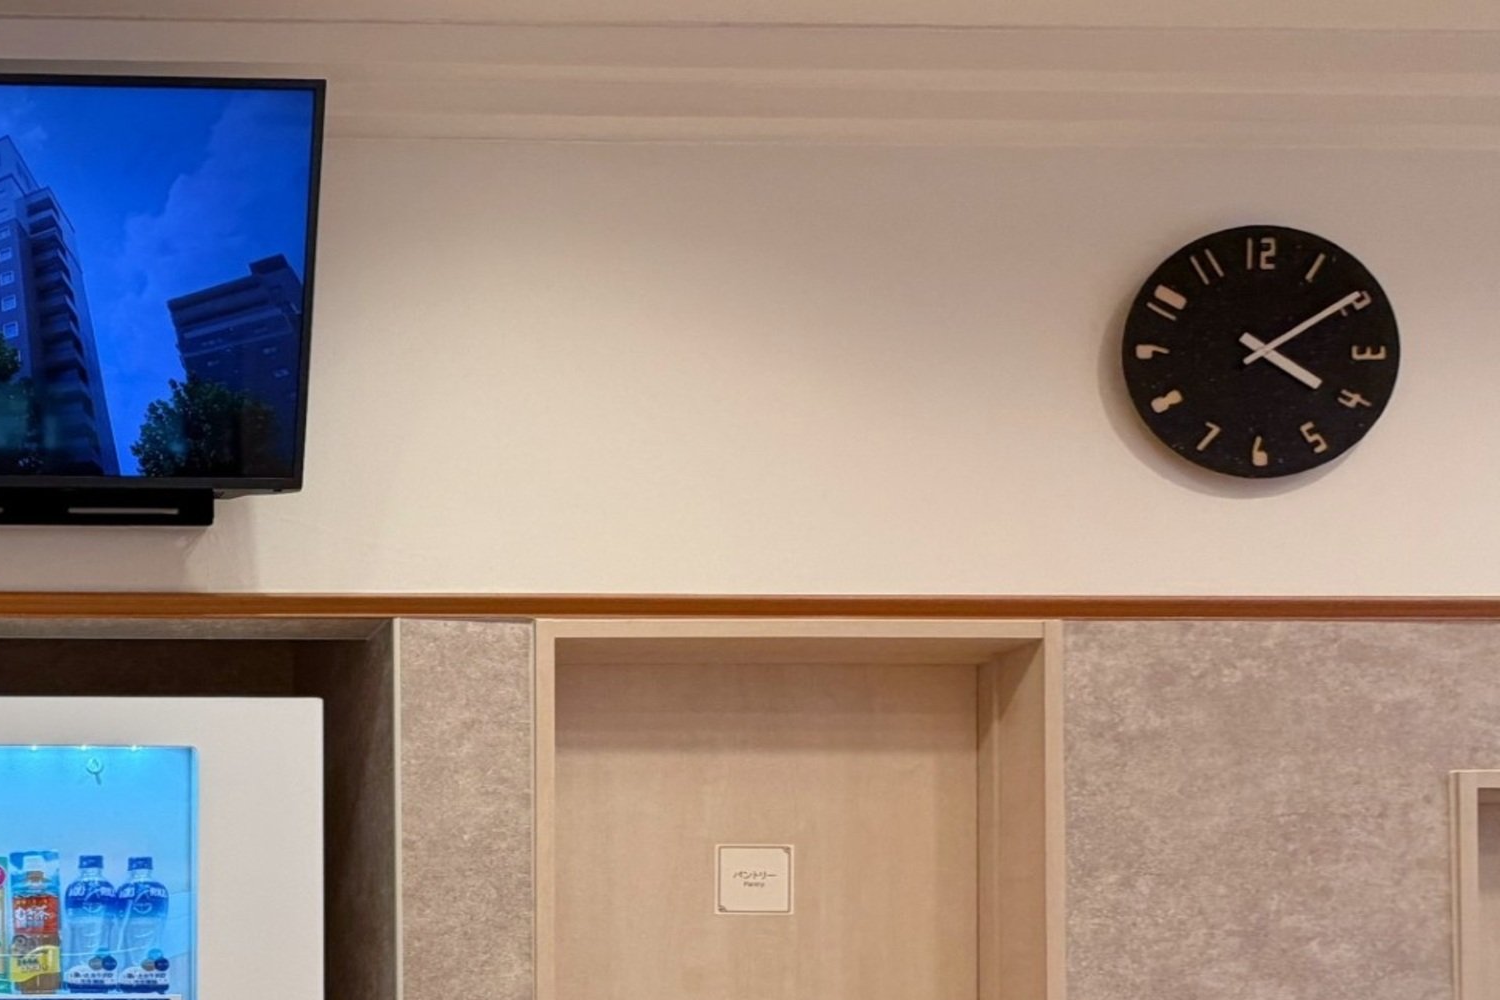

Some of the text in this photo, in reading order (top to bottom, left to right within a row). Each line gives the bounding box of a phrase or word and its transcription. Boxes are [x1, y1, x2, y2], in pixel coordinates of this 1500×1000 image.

[1190, 248, 1224, 285] 11
[1246, 237, 1276, 270] 12
[1305, 253, 1326, 282] 1
[1135, 344, 1169, 359] 9
[1351, 345, 1386, 360] 3
[1151, 389, 1183, 413] 8
[1337, 389, 1371, 408] 4
[1196, 422, 1221, 451] 7
[1252, 436, 1268, 466] 6
[1300, 421, 1328, 453] 5
